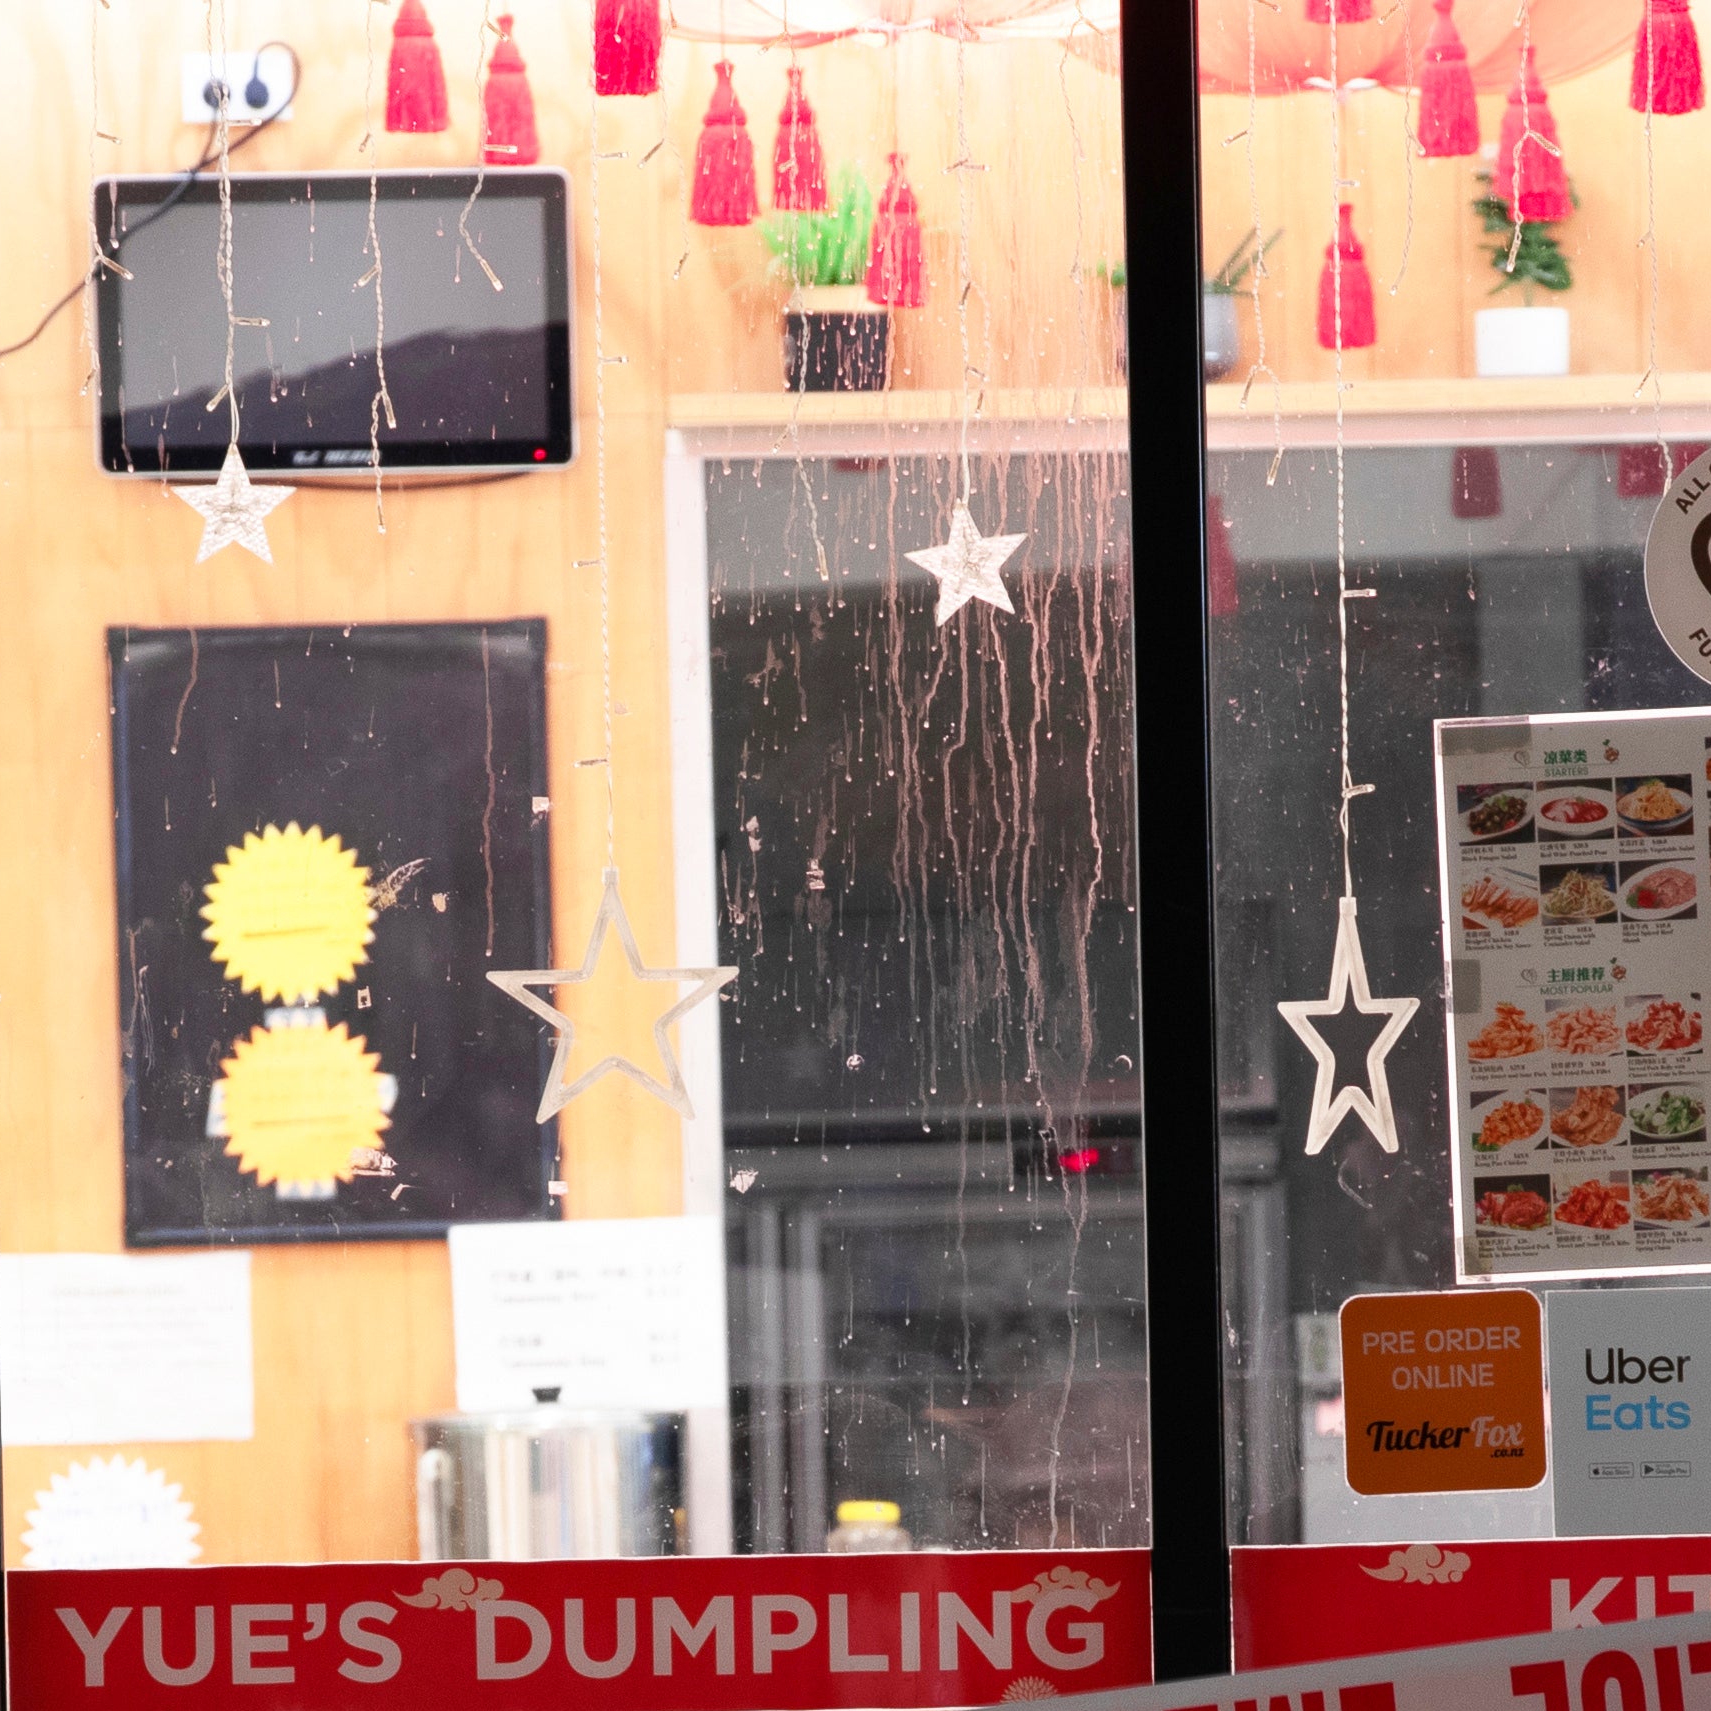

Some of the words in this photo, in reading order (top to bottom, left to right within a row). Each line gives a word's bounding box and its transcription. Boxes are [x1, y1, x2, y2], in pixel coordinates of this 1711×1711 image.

[1675, 477, 1710, 514] ALL
[1544, 766, 1588, 777] STARTERS
[1540, 986, 1568, 995] MOST
[1570, 984, 1613, 994] POPULAR
[1547, 967, 1604, 983] 主厨推荐
[1362, 1331, 1415, 1355] PRE
[1425, 1326, 1521, 1352] ORDER
[1392, 1363, 1494, 1390] ONLINE
[1585, 1348, 1690, 1384] Uber
[1585, 1394, 1690, 1431] Eats
[475, 1588, 1107, 1682] DUMPLING
